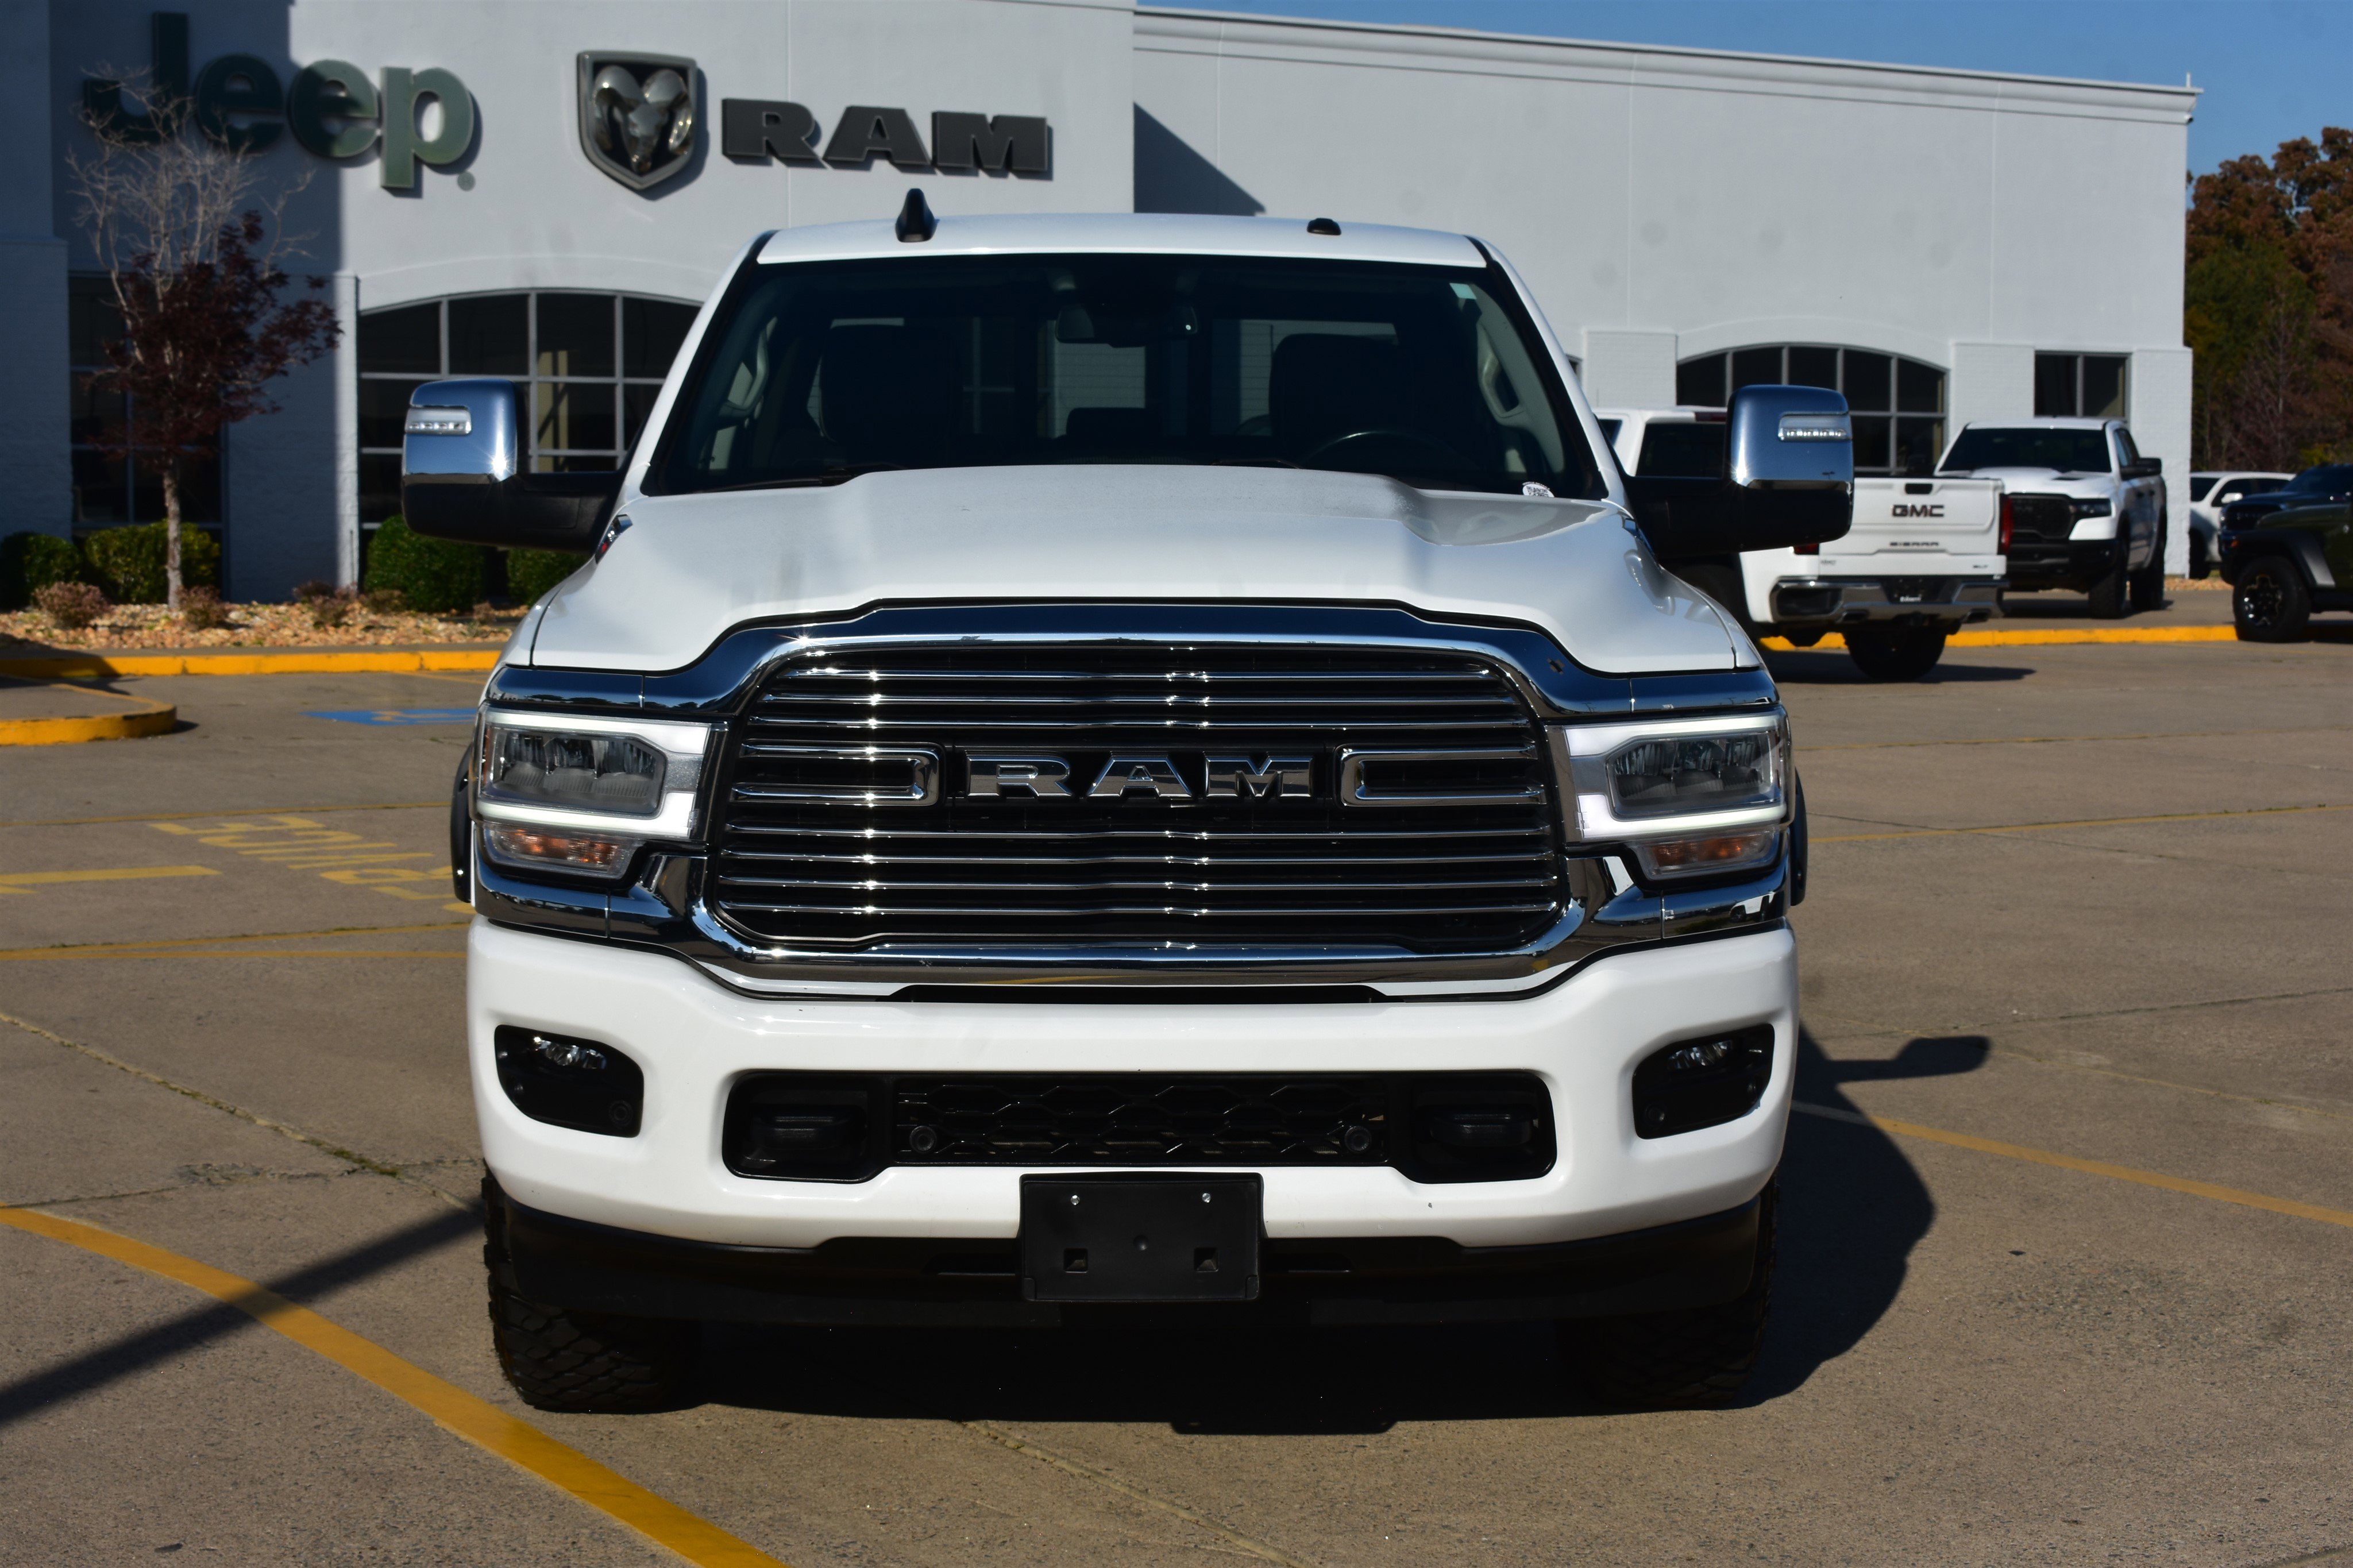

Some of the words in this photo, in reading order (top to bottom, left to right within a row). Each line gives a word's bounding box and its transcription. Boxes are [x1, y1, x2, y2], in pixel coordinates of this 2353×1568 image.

[83, 11, 476, 189] Jeep
[722, 98, 1048, 172] RAM
[1892, 504, 1945, 517] GMC
[966, 752, 1314, 798] RAM
